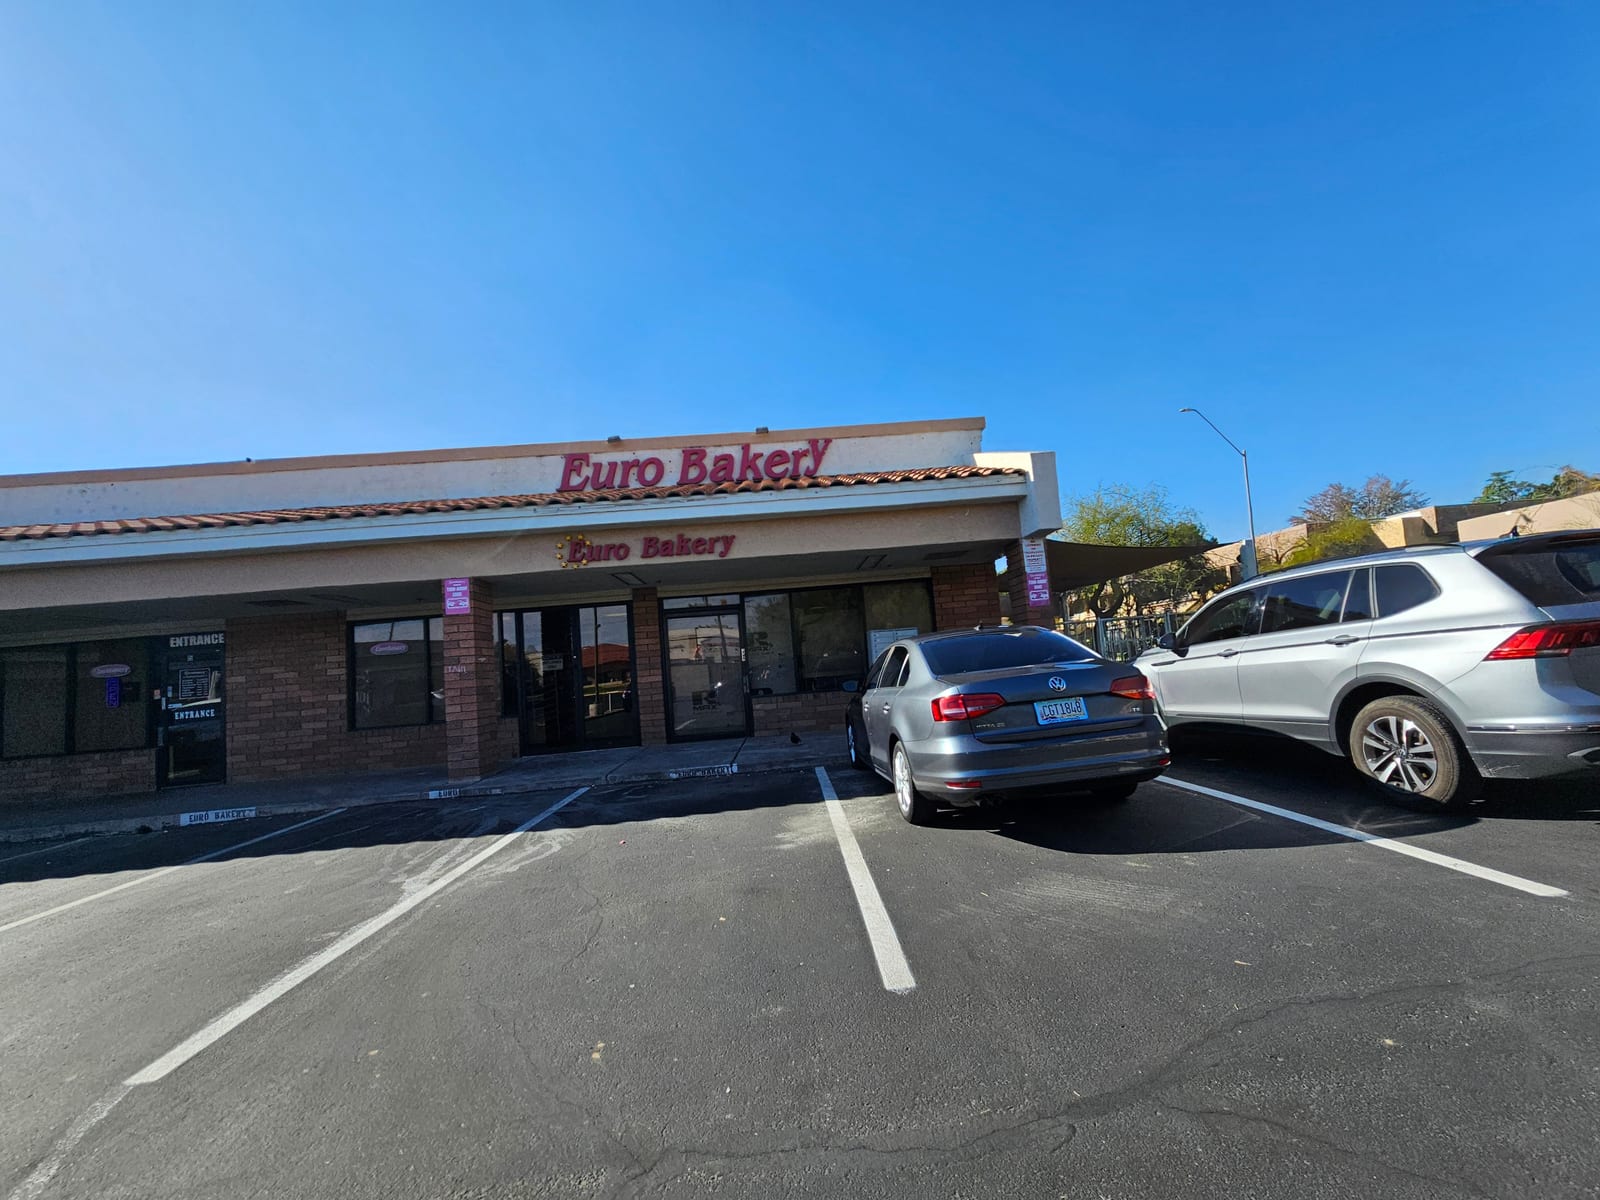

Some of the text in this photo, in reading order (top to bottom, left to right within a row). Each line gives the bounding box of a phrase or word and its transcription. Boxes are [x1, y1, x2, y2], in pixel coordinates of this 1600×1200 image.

[556, 438, 832, 492] Euro Bakery
[567, 533, 736, 563] Euro Bakery
[169, 633, 224, 647] ENTRANCE
[174, 709, 215, 720] ENTRANCE
[1041, 701, 1082, 717] CGT1848
[188, 809, 246, 823] EURO BAKERY
